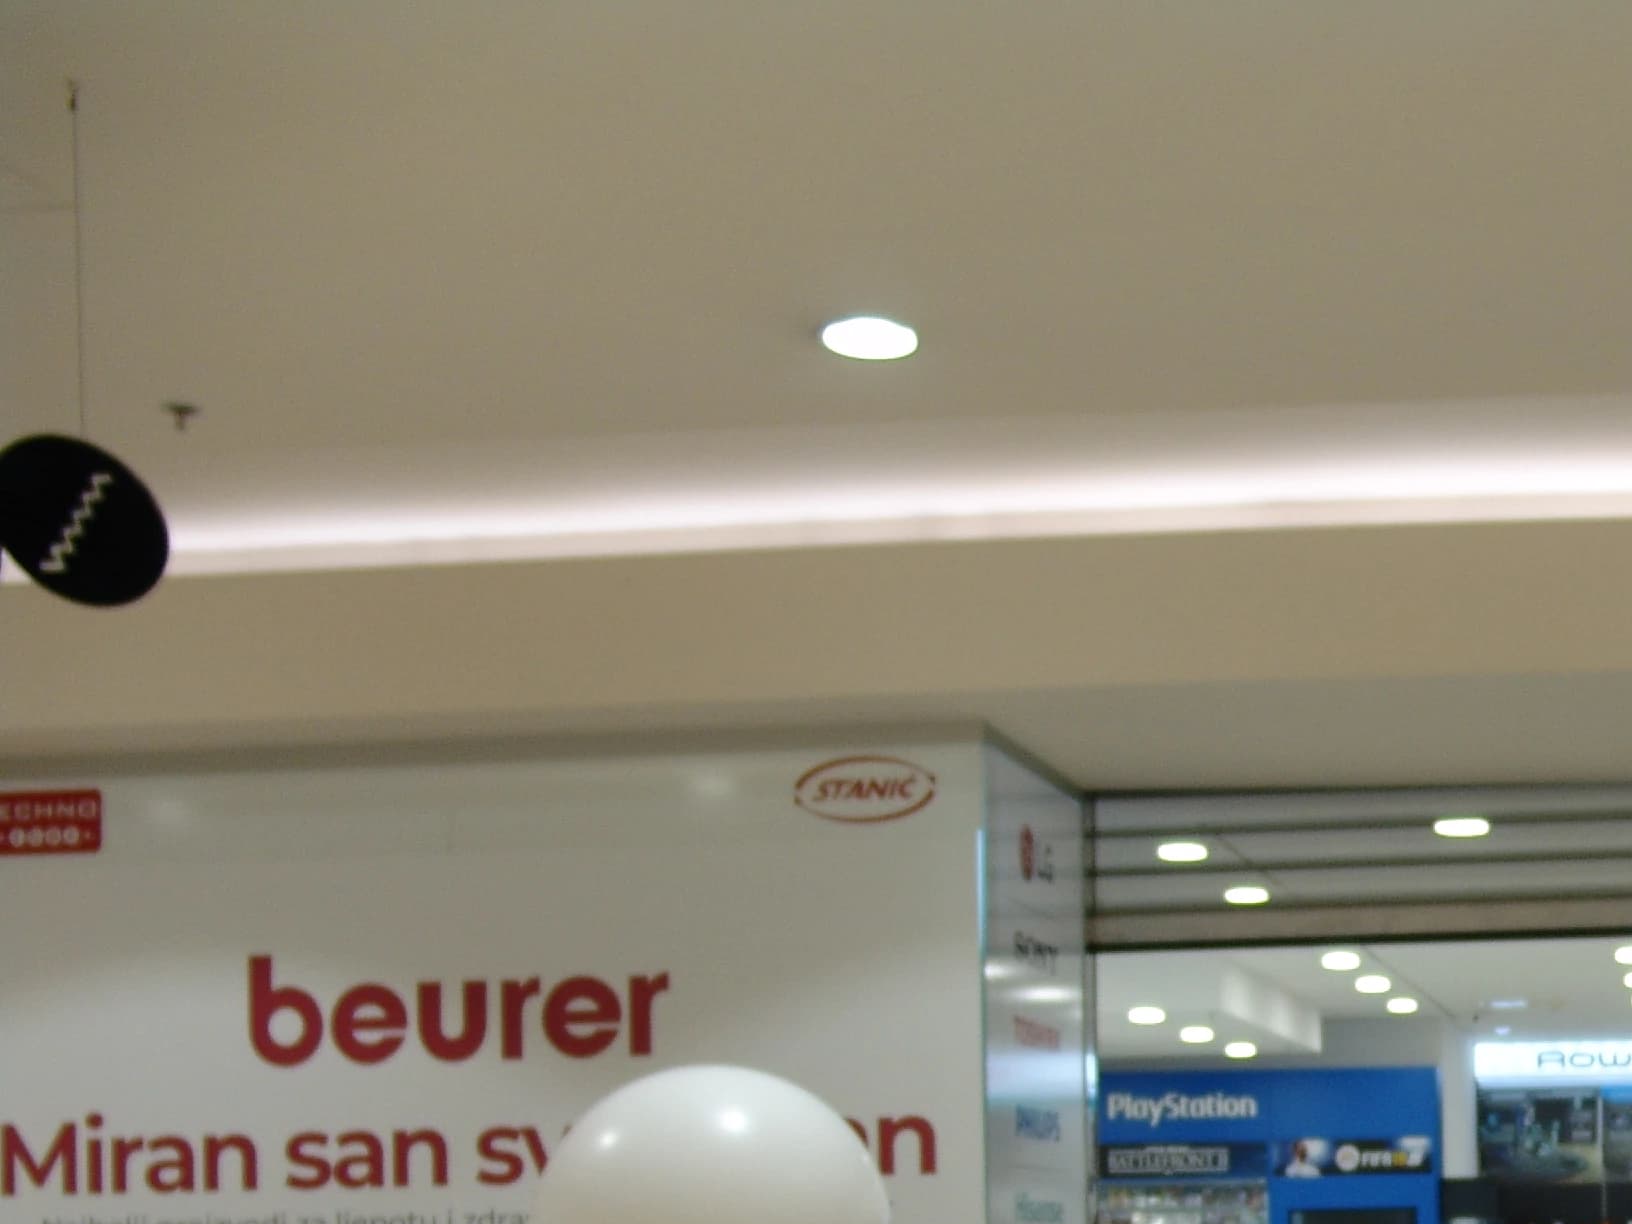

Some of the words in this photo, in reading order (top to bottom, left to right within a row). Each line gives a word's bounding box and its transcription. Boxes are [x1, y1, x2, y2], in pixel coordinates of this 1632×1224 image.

[0, 800, 97, 821] ECHNO
[248, 955, 671, 1067] beurer
[1107, 1093, 1259, 1127] PlayStation
[0, 1112, 258, 1196] Miran
[285, 1128, 450, 1190] san
